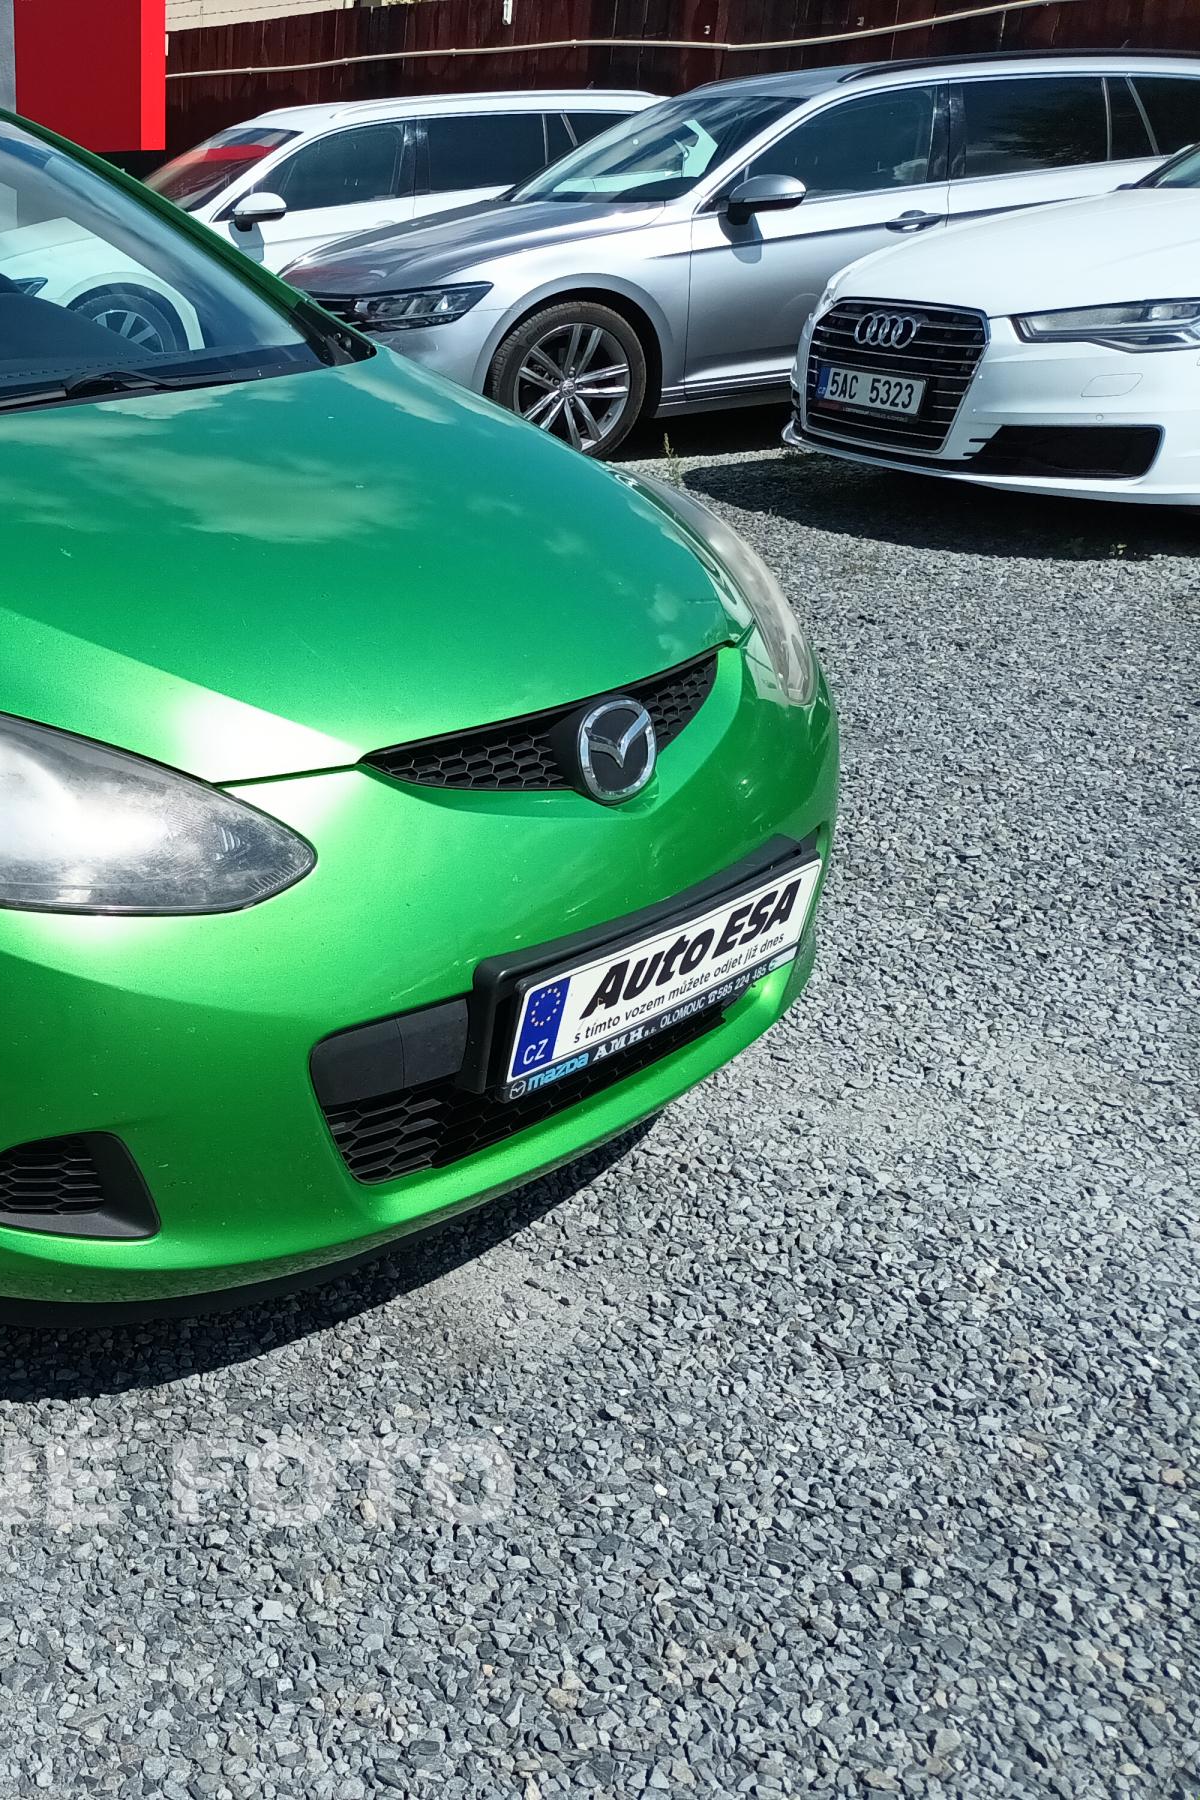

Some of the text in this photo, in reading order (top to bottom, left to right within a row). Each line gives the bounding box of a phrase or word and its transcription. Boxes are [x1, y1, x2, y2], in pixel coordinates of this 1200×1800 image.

[829, 371, 915, 409] 5AC 5323
[579, 878, 802, 1021] Auto ESA
[573, 932, 785, 1044] s tímto vozem můžete odjet již dnes
[659, 998, 706, 1029] OLOMOUC
[734, 972, 750, 990] 224
[522, 1038, 549, 1066] CZ
